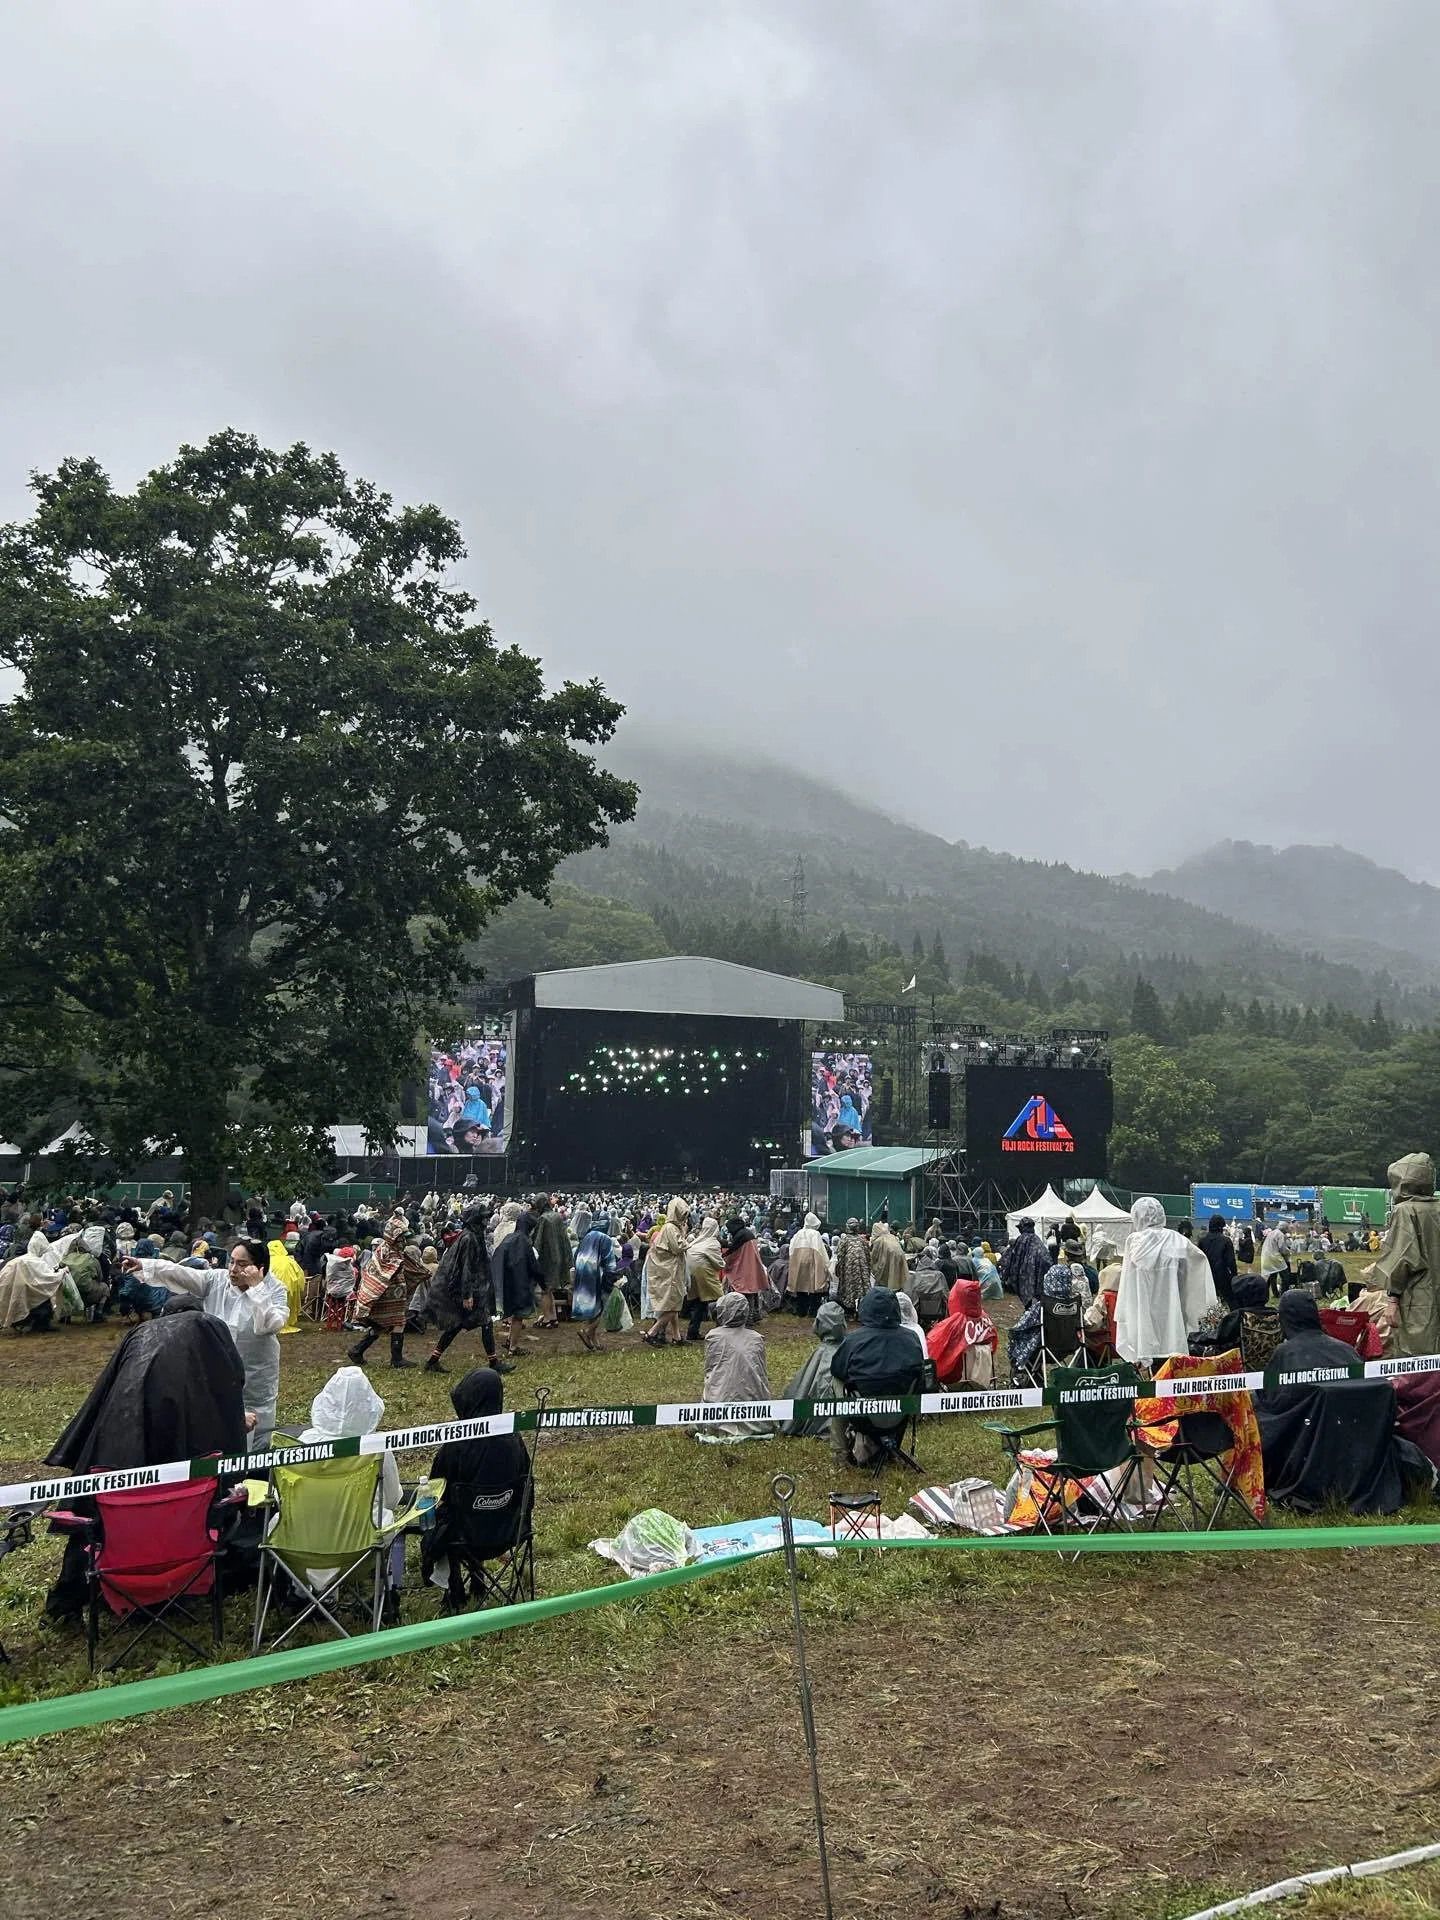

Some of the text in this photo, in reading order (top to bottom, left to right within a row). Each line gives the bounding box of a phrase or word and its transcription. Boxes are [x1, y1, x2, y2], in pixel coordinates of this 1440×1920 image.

[1002, 1141, 1016, 1151] FUJI
[1017, 1141, 1035, 1151] ROCK
[1036, 1141, 1063, 1152] FESTIVAL
[1227, 1198, 1244, 1206] FES
[1380, 1358, 1440, 1375] FUJI ROCK FESTIV
[1279, 1367, 1349, 1385] FUJI ROCK FESTIVAL
[1173, 1378, 1246, 1394] FUJI ROCK FESTIVAL
[940, 1394, 1023, 1410] FUJI ROCK FESTIVAL
[1060, 1386, 1138, 1403] FUJI ROCK FESTIVAL
[679, 1405, 772, 1421] FUJI ROCK FESTIVAL
[813, 1400, 901, 1416] FUJI ROCK FESTIVAL
[559, 1412, 588, 1426] ROCK
[590, 1410, 633, 1426] FESTIVAL
[385, 1421, 490, 1449] FUJI ROCK FESTIVAL
[217, 1444, 335, 1474] FUJI ROCK FESTIVAL
[30, 1469, 160, 1500] FUJI ROCK FESTIVAL
